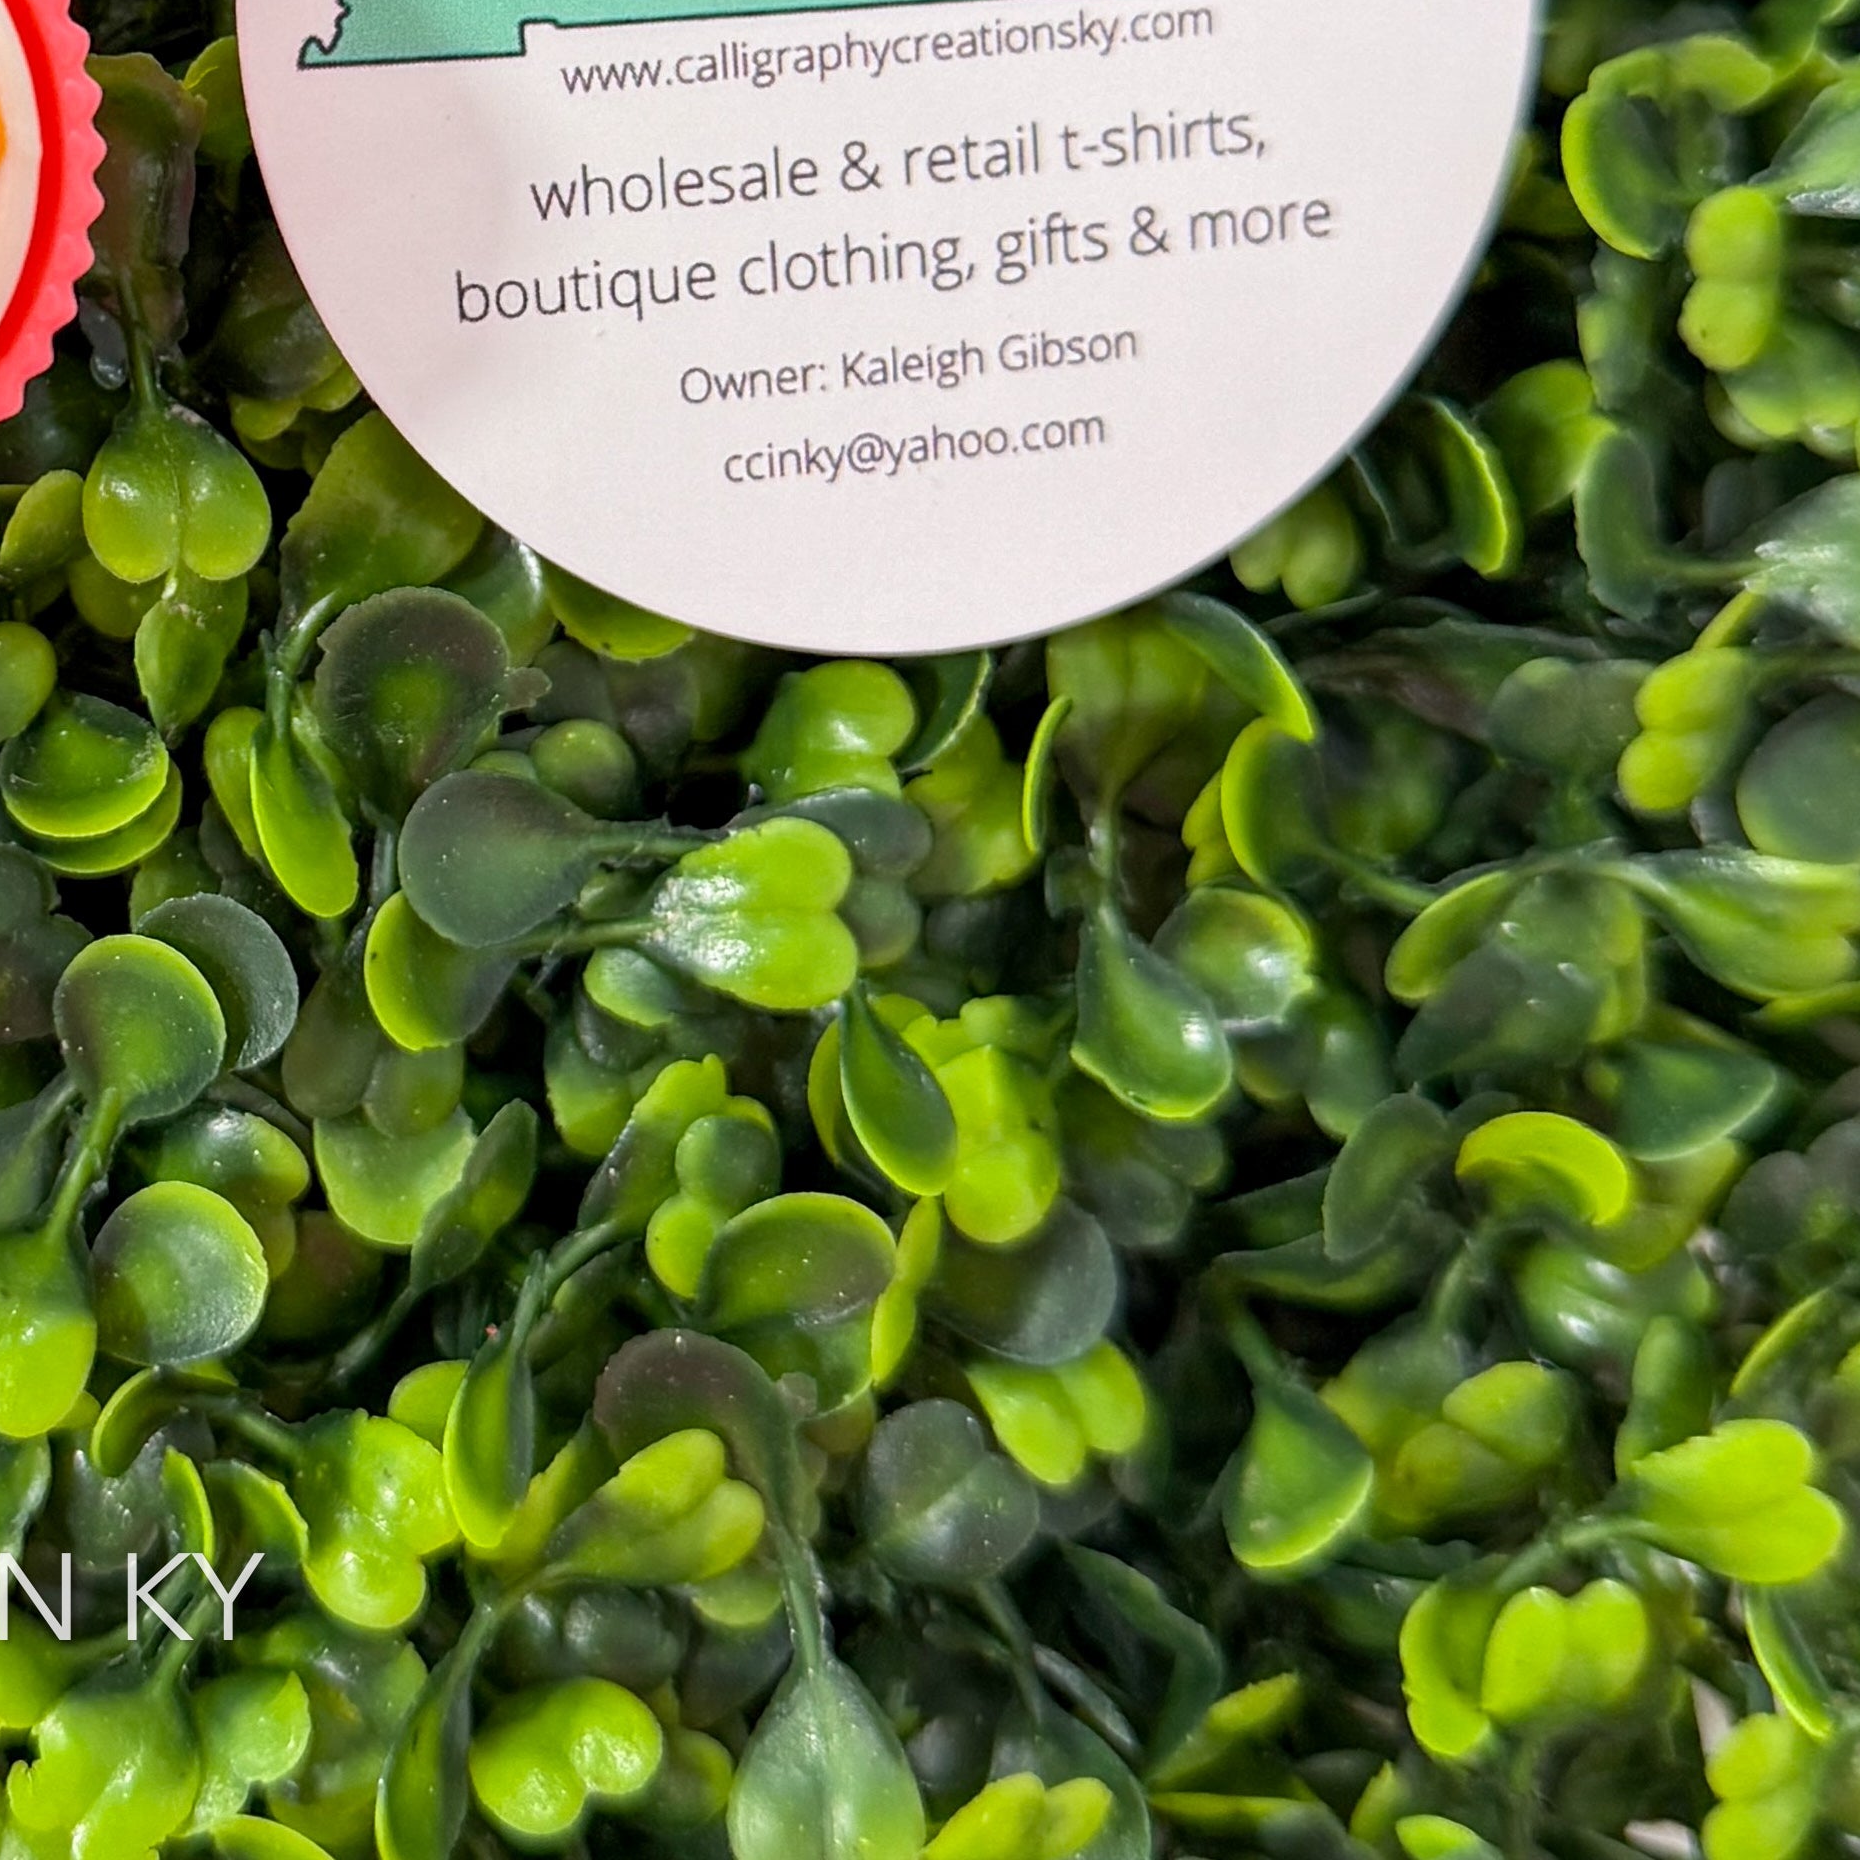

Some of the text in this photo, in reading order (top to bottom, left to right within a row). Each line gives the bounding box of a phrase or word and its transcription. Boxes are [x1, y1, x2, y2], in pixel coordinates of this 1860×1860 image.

[560, 6, 1214, 95] www.calligraphycreationsky.com
[531, 110, 1268, 221] wholesale & retail t-shirts,
[456, 196, 1333, 324] boutique clothing, gifts & more
[680, 326, 1138, 404] Owner: Kaleigh Gibson
[723, 412, 1106, 484] ccinky@yahoo.com
